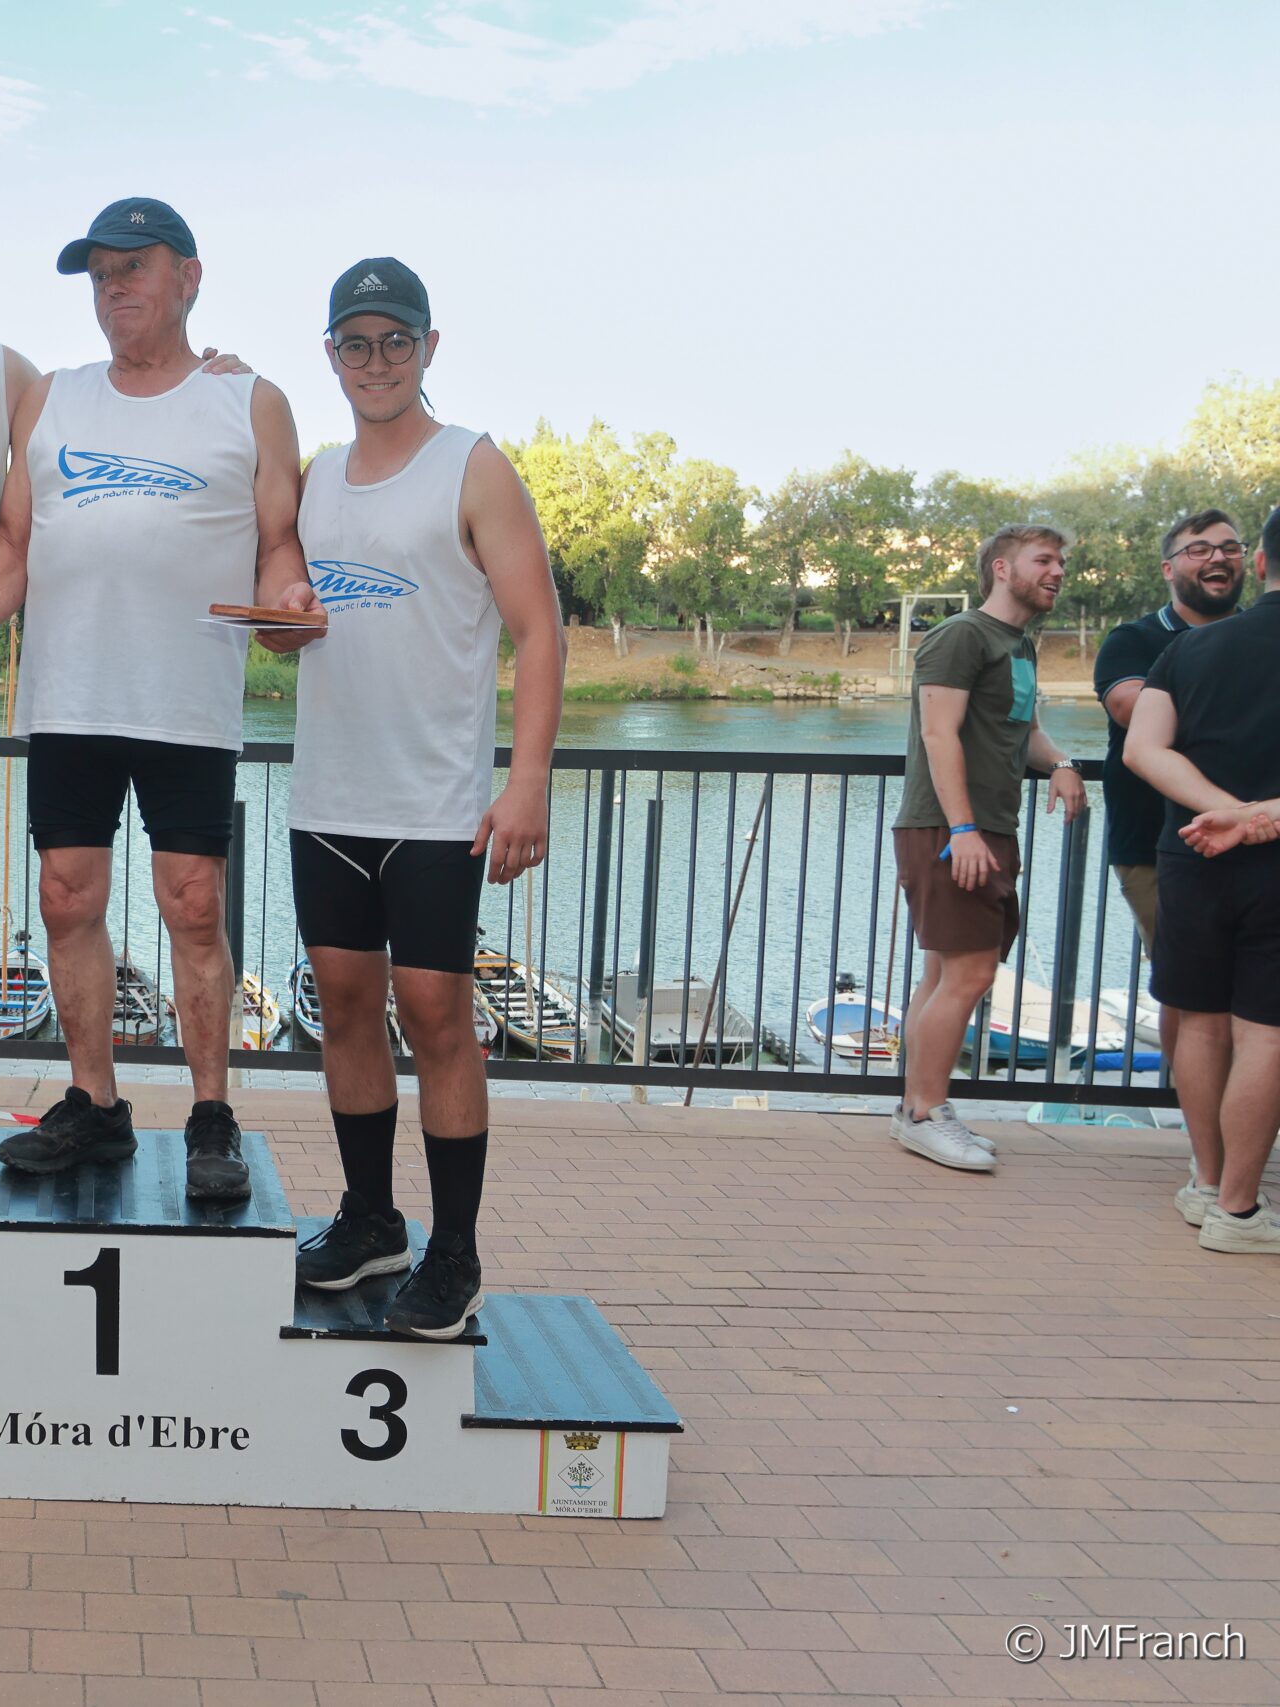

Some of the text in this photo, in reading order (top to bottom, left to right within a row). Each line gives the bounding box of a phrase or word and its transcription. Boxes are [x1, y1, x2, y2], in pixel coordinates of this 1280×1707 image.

[353, 283, 389, 295] adidas
[77, 493, 101, 508] Club
[143, 487, 156, 497] de
[159, 491, 179, 501] rem
[360, 598, 371, 608] de
[374, 601, 392, 610] rem
[64, 1247, 120, 1376] 1
[340, 1368, 408, 1462] 3
[108, 1414, 251, 1451] d'Ebre
[550, 1498, 597, 1506] AJUNTAMENT
